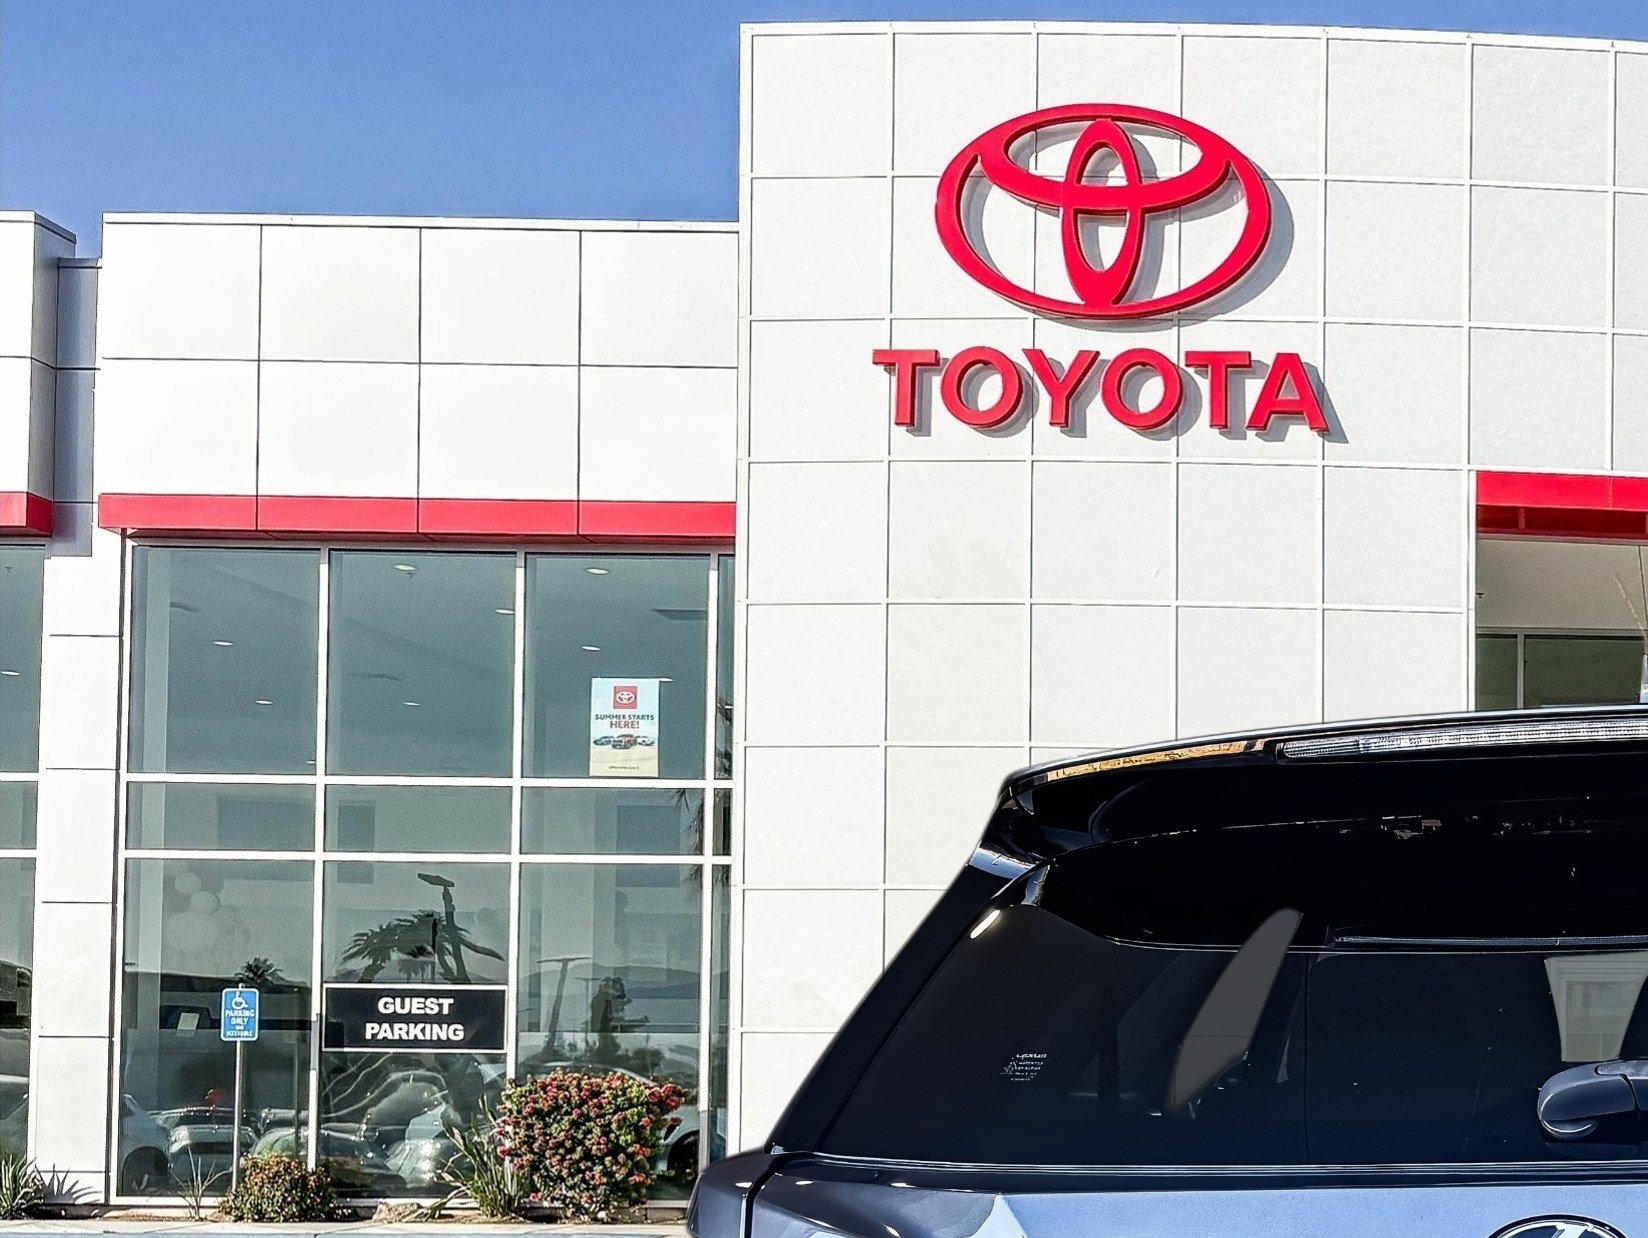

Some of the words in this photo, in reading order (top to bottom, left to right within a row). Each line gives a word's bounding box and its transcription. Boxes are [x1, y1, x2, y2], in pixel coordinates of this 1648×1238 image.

[873, 346, 1328, 432] TOYOTA
[609, 720, 640, 729] HERE!
[378, 996, 454, 1015] GUEST
[225, 1009, 255, 1017] PARKING
[231, 1017, 249, 1025] ONLY
[365, 1023, 465, 1042] PARKING
